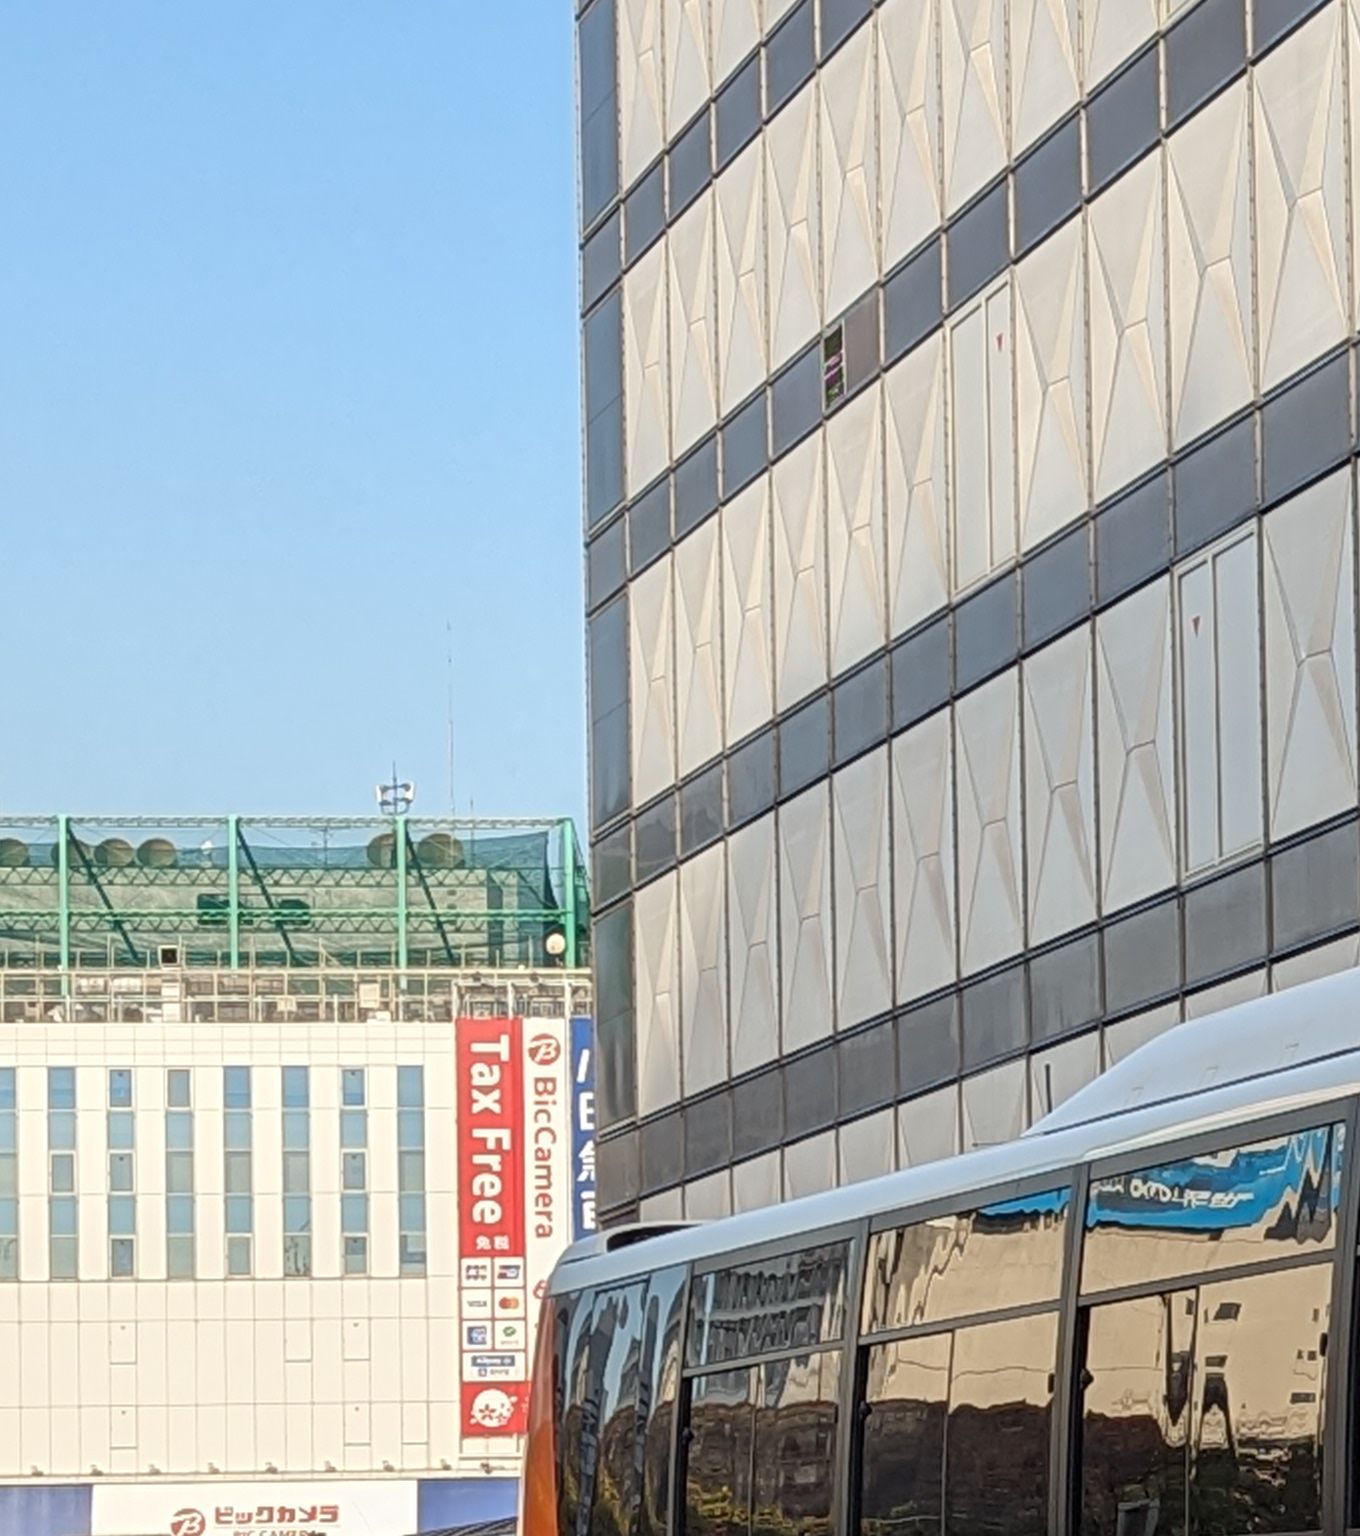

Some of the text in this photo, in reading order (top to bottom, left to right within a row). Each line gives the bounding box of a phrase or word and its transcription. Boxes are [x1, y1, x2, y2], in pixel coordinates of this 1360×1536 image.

[468, 1034, 510, 1116] Tax
[470, 1127, 511, 1226] Free
[533, 1076, 559, 1241] BicCamera
[214, 1504, 339, 1525] ビックカメラ
